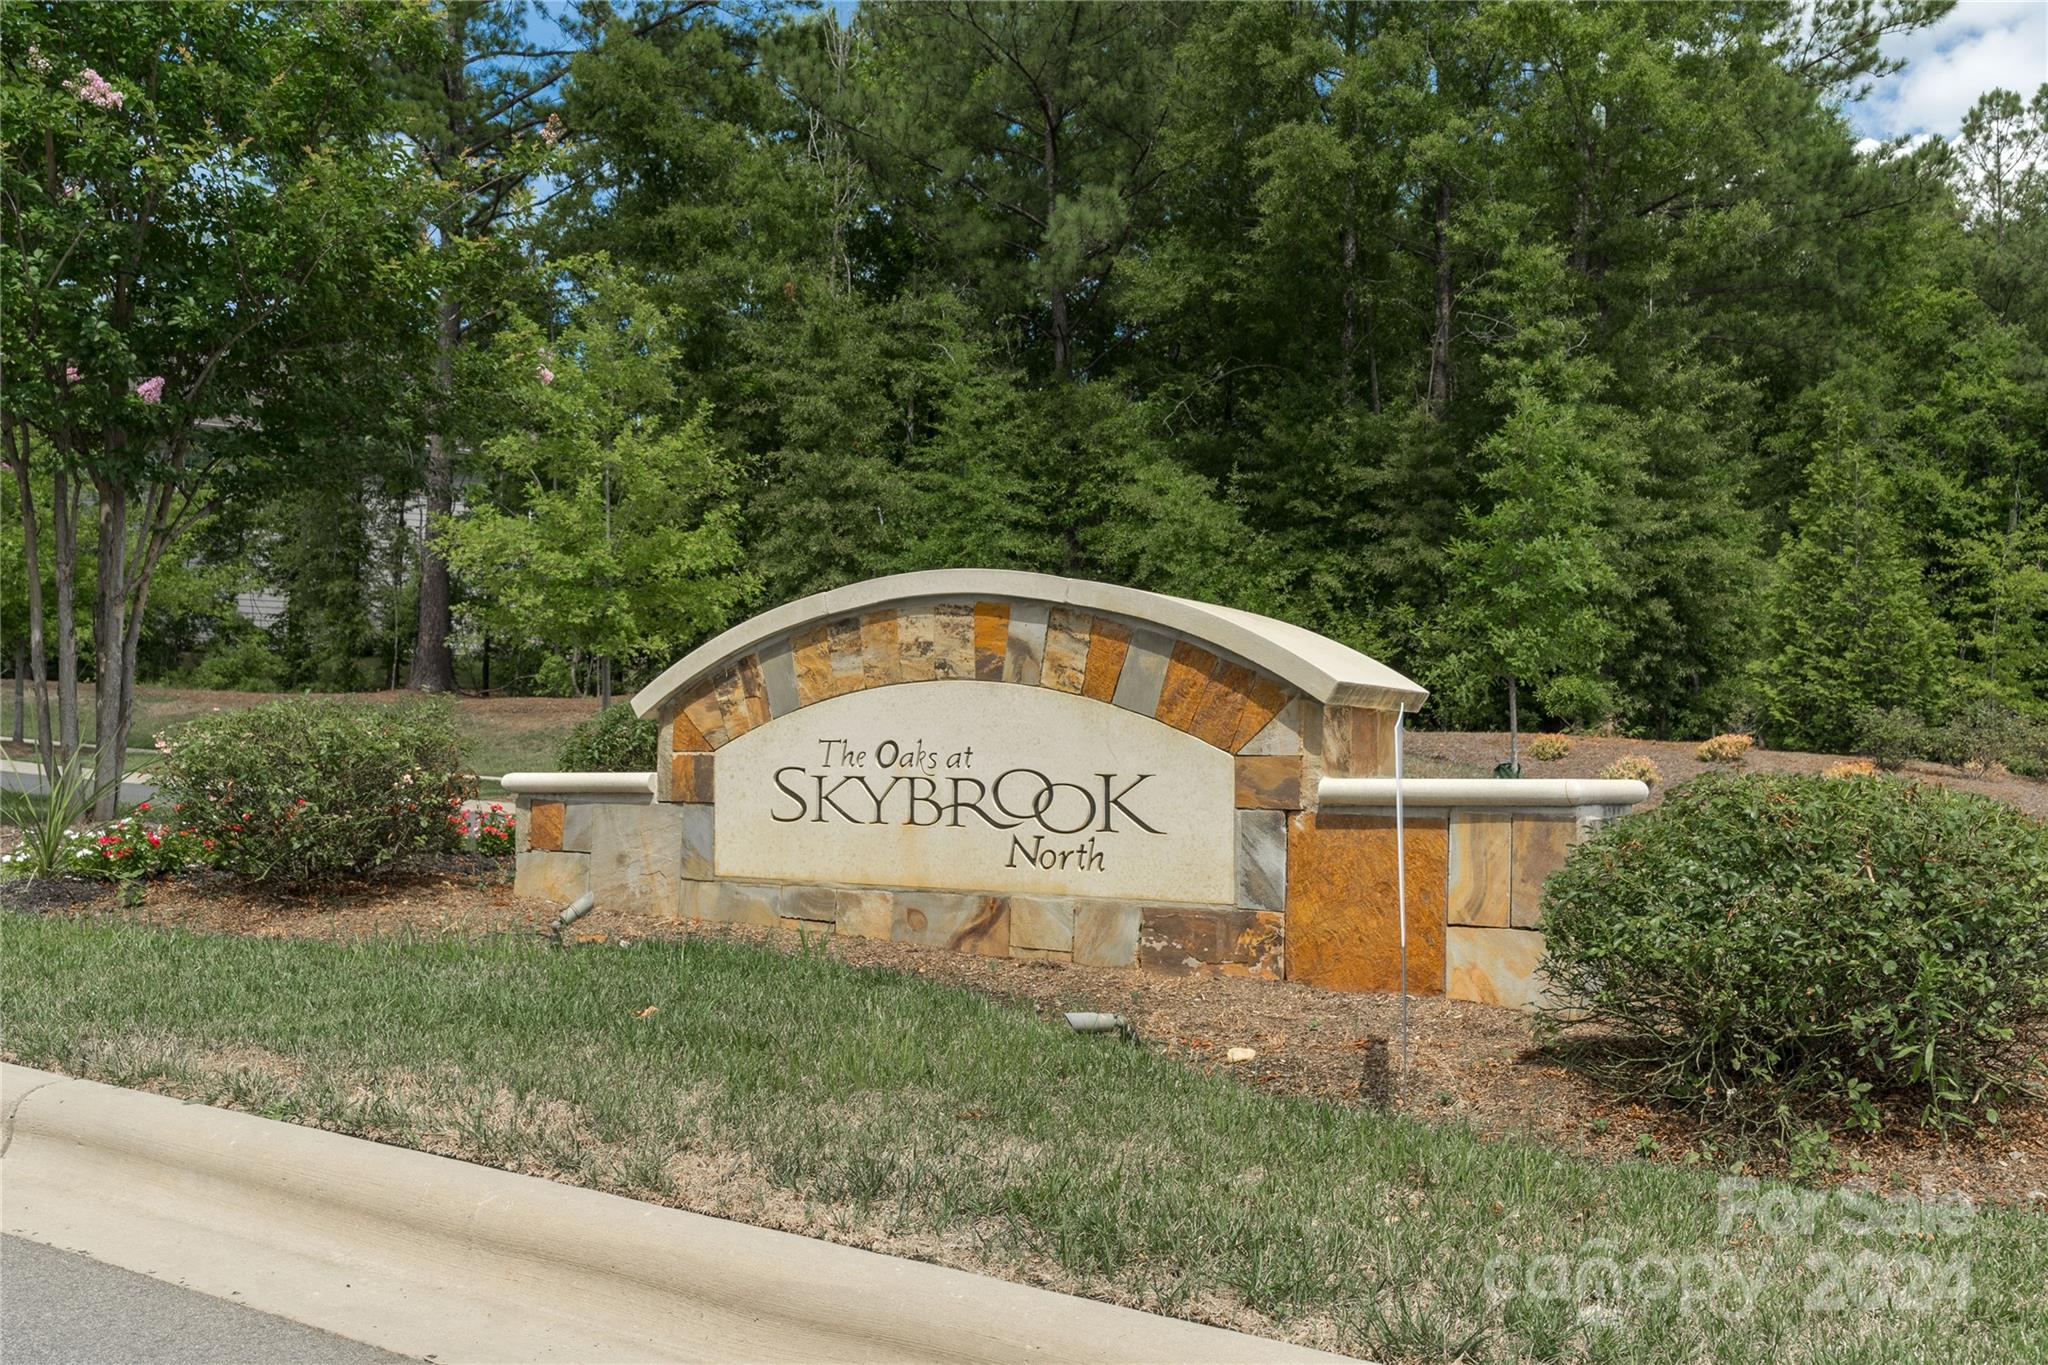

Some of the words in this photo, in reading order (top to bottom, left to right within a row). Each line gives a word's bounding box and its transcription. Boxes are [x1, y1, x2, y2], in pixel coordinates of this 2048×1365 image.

[818, 738, 865, 769] The
[874, 739, 937, 777] Oaks
[946, 746, 974, 769] at
[770, 766, 1167, 835] SKYBROOK
[1005, 834, 1106, 873] North
